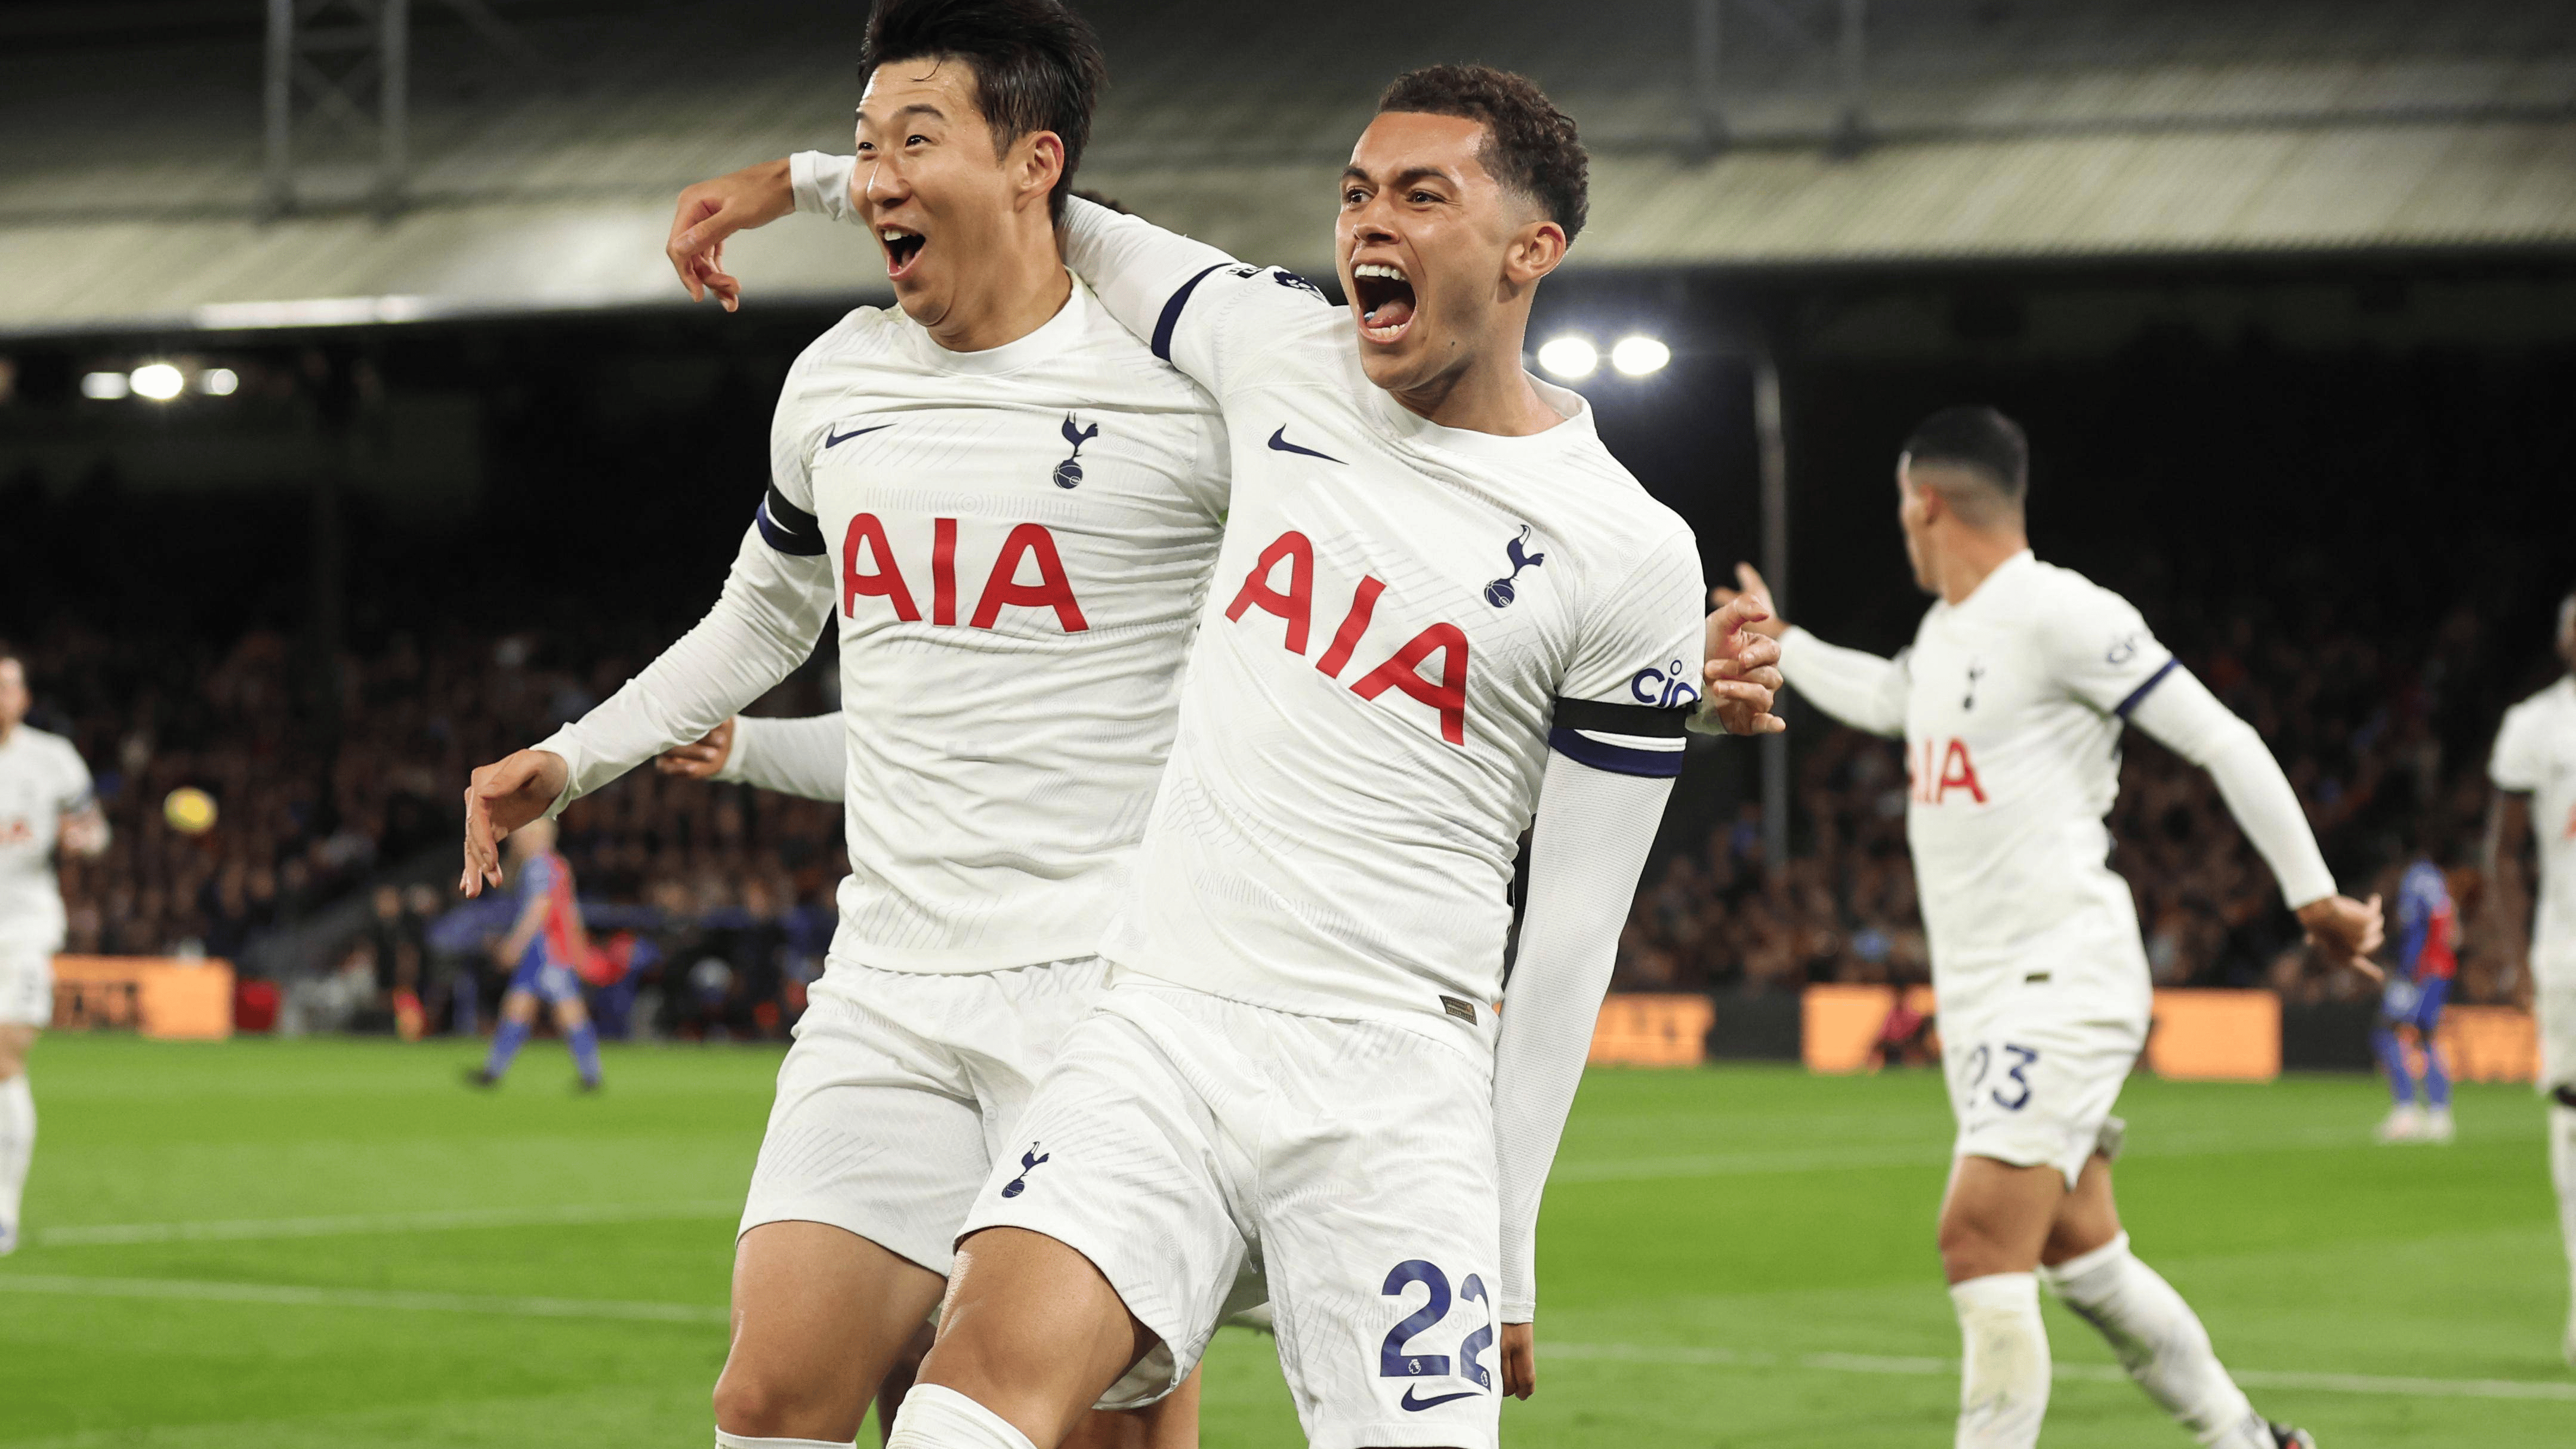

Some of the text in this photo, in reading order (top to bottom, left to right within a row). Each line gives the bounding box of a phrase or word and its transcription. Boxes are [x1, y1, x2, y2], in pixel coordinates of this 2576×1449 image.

[843, 512, 1090, 633] AIA
[1224, 530, 1469, 747] AIA
[1380, 1259, 1494, 1393] 22
